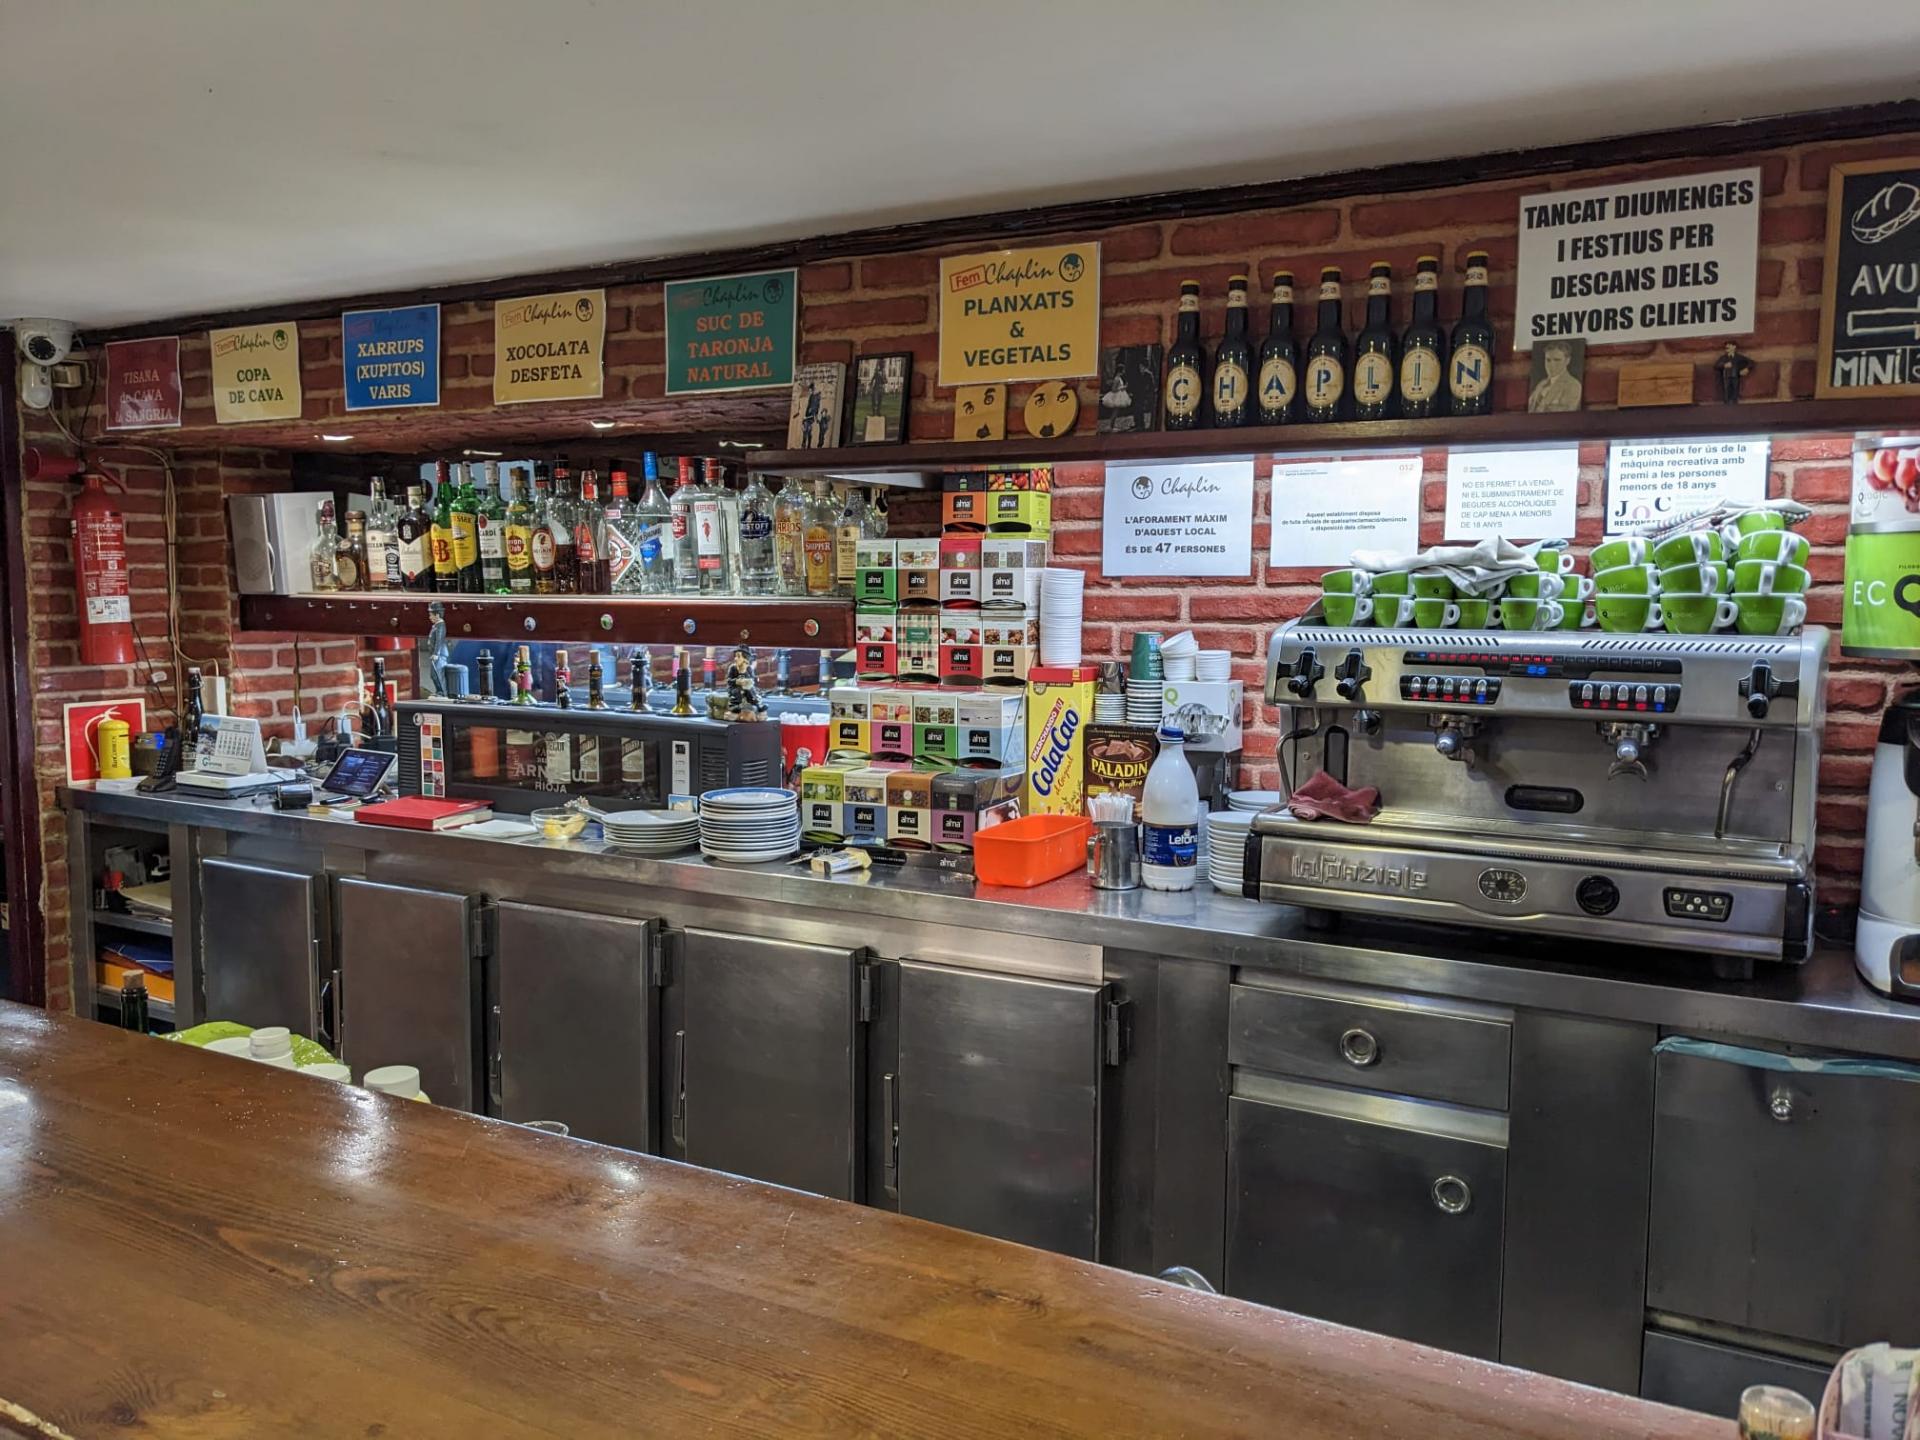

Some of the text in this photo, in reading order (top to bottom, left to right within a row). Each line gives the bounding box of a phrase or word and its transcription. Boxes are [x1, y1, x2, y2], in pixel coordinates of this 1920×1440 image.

[1525, 179, 1754, 230] TANCAT DIUMENGES
[1557, 223, 1714, 262] I FESTIUS PER
[955, 259, 1054, 289] Fem Chaplin
[1550, 260, 1719, 300] DESCANS DELS
[964, 290, 1074, 316] PLANXATS
[523, 301, 573, 325] Chaplin
[1531, 297, 1737, 337] SENYORS CLIENTS
[696, 312, 765, 332] SUC DE
[1010, 321, 1025, 338] &
[233, 333, 271, 353] Chaplin
[357, 339, 424, 357] XARRUPS
[687, 336, 773, 359] TARONJA
[506, 340, 590, 361] XOCOLATA
[964, 343, 1072, 367] VEGETALS
[236, 368, 271, 382] COPA
[356, 360, 425, 382] (XUPITOS)
[510, 364, 582, 383] DESFETA
[687, 362, 773, 383] NATURAL
[229, 388, 284, 404] DE CAVA
[368, 384, 411, 400] VARIS
[125, 407, 174, 423] SANGRIA
[1637, 446, 1685, 458] prohibeix
[1688, 445, 1703, 454] fer
[1721, 444, 1734, 453] de
[1737, 443, 1747, 452] la
[1667, 457, 1719, 467] recreativa
[1722, 456, 1745, 465] amb
[1620, 470, 1649, 481] premi
[1660, 469, 1675, 478] les
[1678, 469, 1728, 480] persones
[1160, 475, 1221, 499] Chaplin
[1462, 481, 1474, 489] NO
[1486, 480, 1517, 488] PERMET
[1518, 479, 1527, 487] LA
[1619, 481, 1717, 491] menors de 18 anys
[1481, 489, 1551, 498] SUBMINISTRAMENT
[955, 499, 971, 508] alma
[1001, 499, 1016, 508] alma
[1461, 501, 1497, 509] BEGUDES
[1125, 512, 1228, 525] L'AFORAMENT MÀXIM
[1489, 510, 1511, 518] MENA
[1519, 509, 1552, 517] MENORS
[1134, 527, 1216, 537] D'AQUEST LOCAL
[1125, 542, 1226, 554] ÉS DE 47 PERSONES
[867, 576, 882, 584] alma
[910, 575, 926, 584] alma
[953, 576, 968, 585] alma
[995, 577, 1011, 585] alma
[868, 650, 882, 659] alma
[953, 651, 969, 661] alma
[996, 653, 1012, 663] alma
[842, 728, 856, 736] alma
[884, 729, 899, 738] alma
[927, 732, 943, 741] alma
[972, 734, 988, 743] alma
[1031, 708, 1079, 797] ColaCao
[1091, 758, 1148, 778] PALADIN
[815, 807, 830, 817] alma
[857, 810, 873, 821] alma
[900, 814, 916, 824] alma
[945, 818, 962, 829] alma
[939, 858, 957, 868] alma
